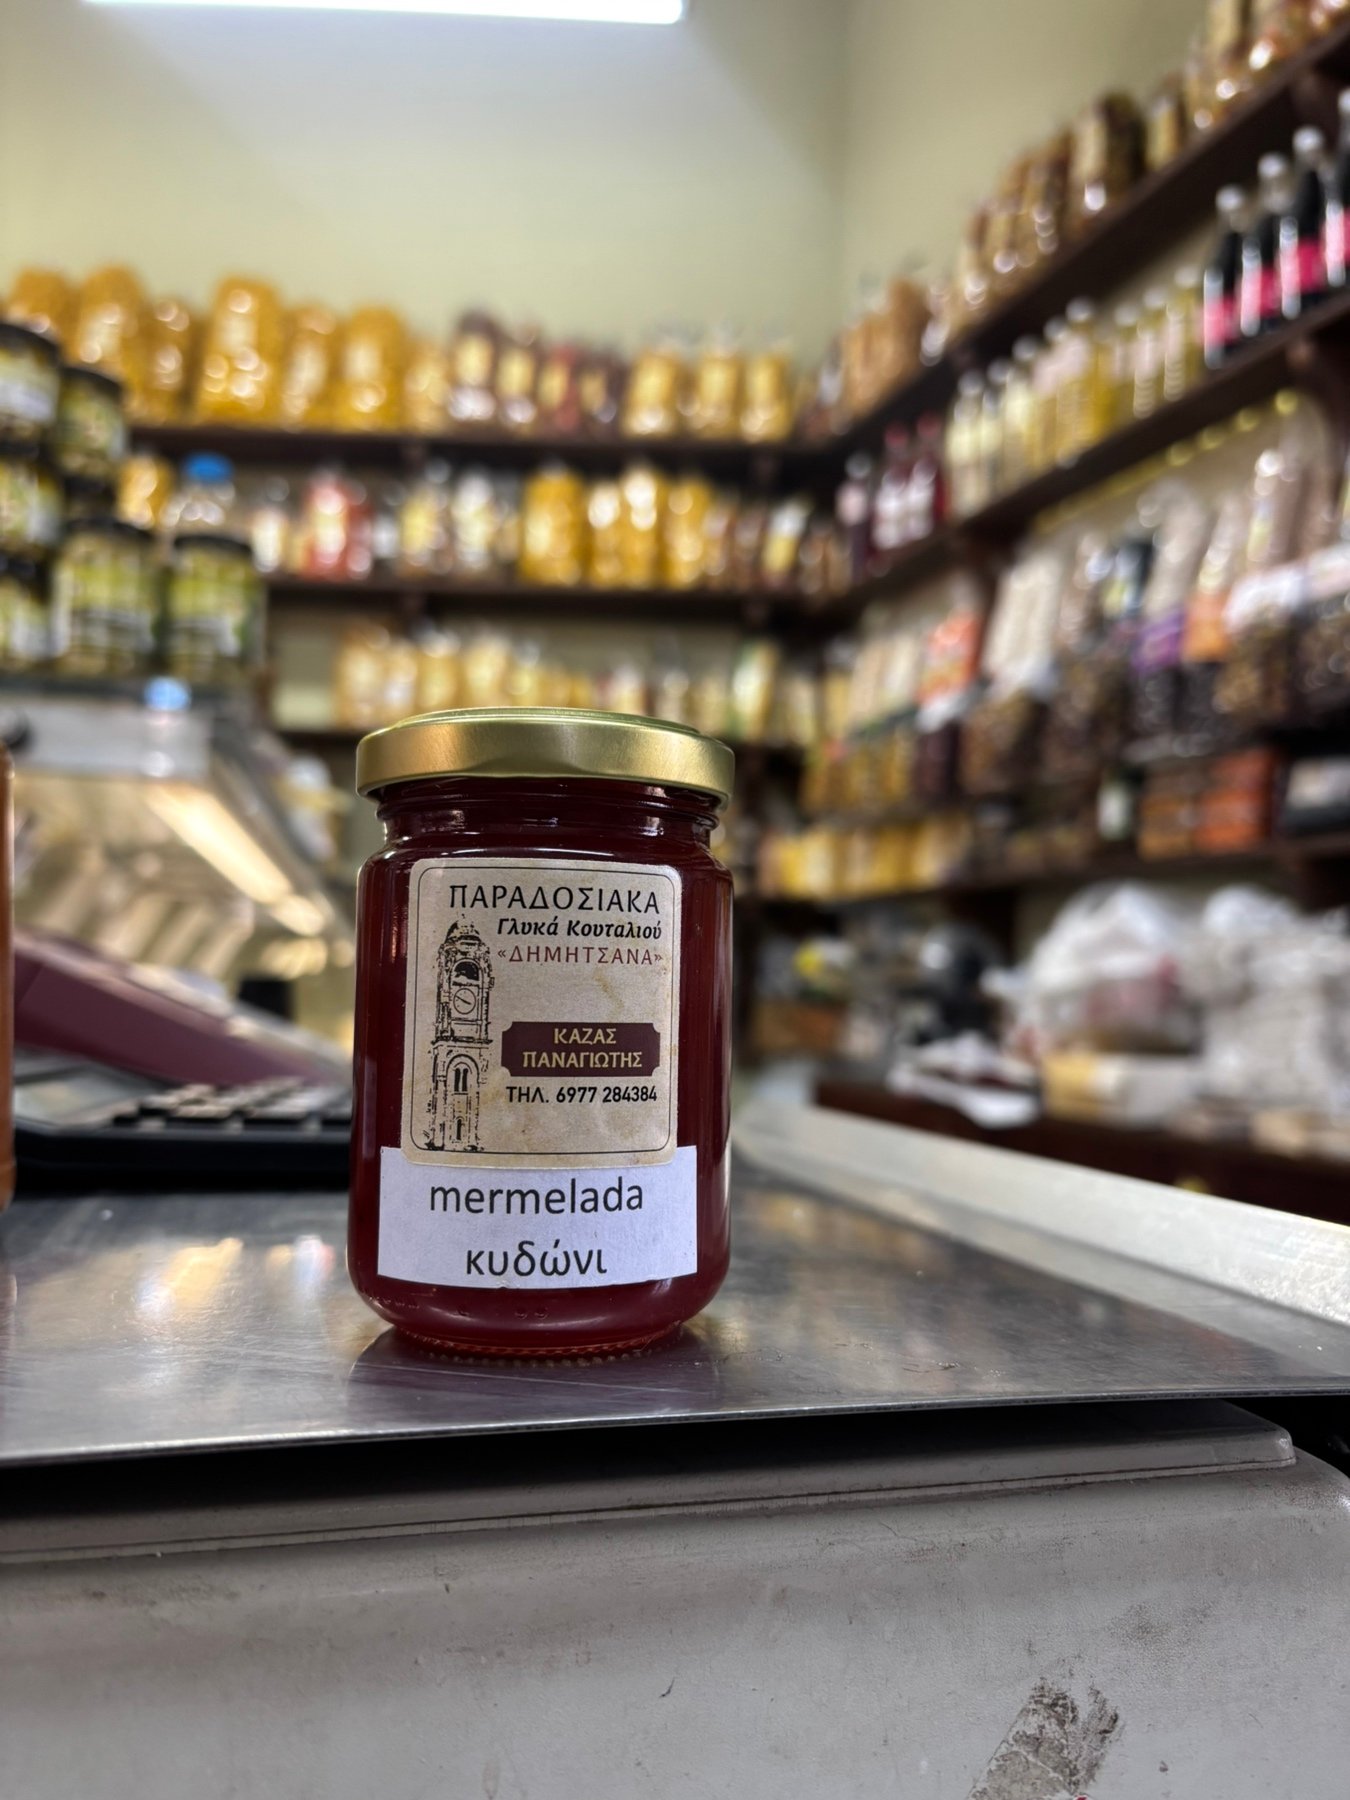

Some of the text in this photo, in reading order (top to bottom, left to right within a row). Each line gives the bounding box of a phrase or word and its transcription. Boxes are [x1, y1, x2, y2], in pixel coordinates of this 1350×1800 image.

[449, 885, 660, 914] ΠΑΡΑΔΟΣΙΑΚΑ
[497, 918, 662, 940] Γλυκά Κουταλιού
[497, 946, 664, 965] «ΔΗΜΗΤΣΑΝΑ»
[554, 1028, 617, 1045] ΚΑΖΑΣ
[522, 1051, 643, 1068] ΠΑΝΑΓΙΩΤΗΣ
[506, 1086, 658, 1103] ΤΗΛ. 6977 284384
[430, 1176, 643, 1214] mermelada
[466, 1239, 607, 1277] κυδώνι
